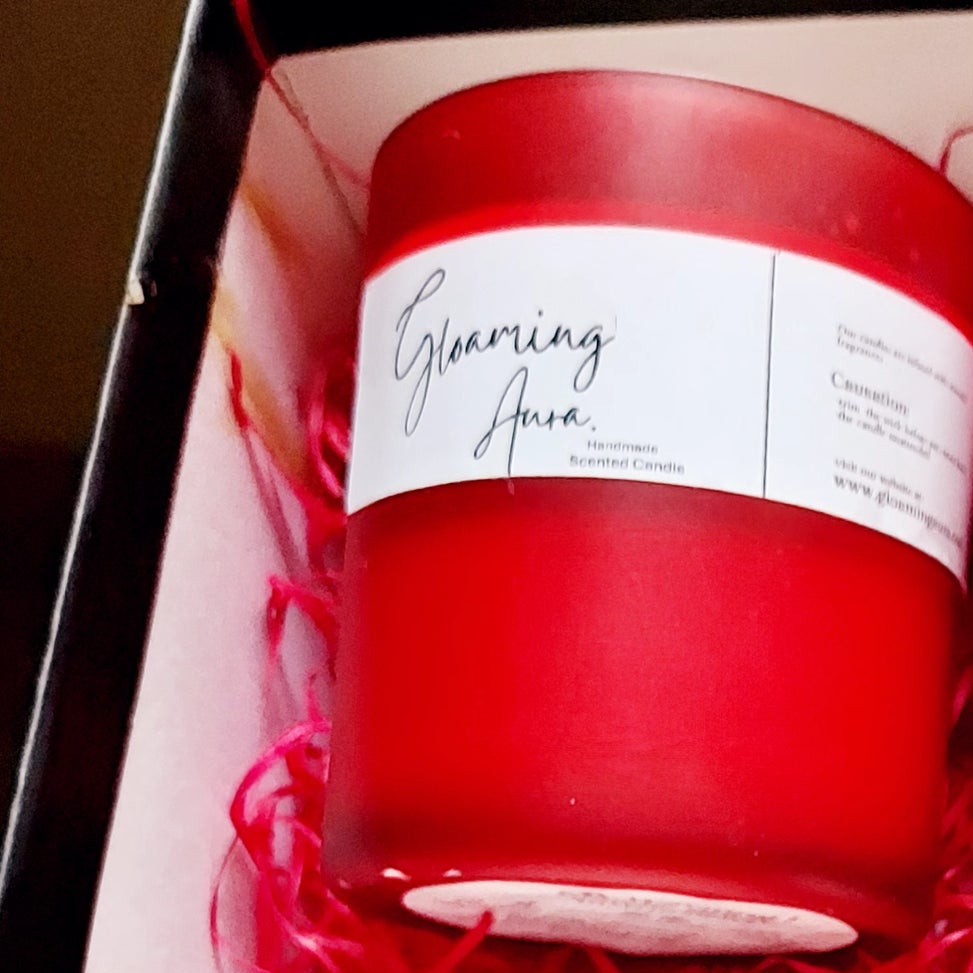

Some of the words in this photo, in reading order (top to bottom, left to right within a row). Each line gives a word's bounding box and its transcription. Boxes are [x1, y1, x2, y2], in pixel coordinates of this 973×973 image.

[395, 268, 613, 436] Gloaming
[474, 367, 598, 478] Aura.
[586, 439, 660, 455] Handmade
[569, 455, 630, 471] Scented
[632, 458, 686, 475] Candle
